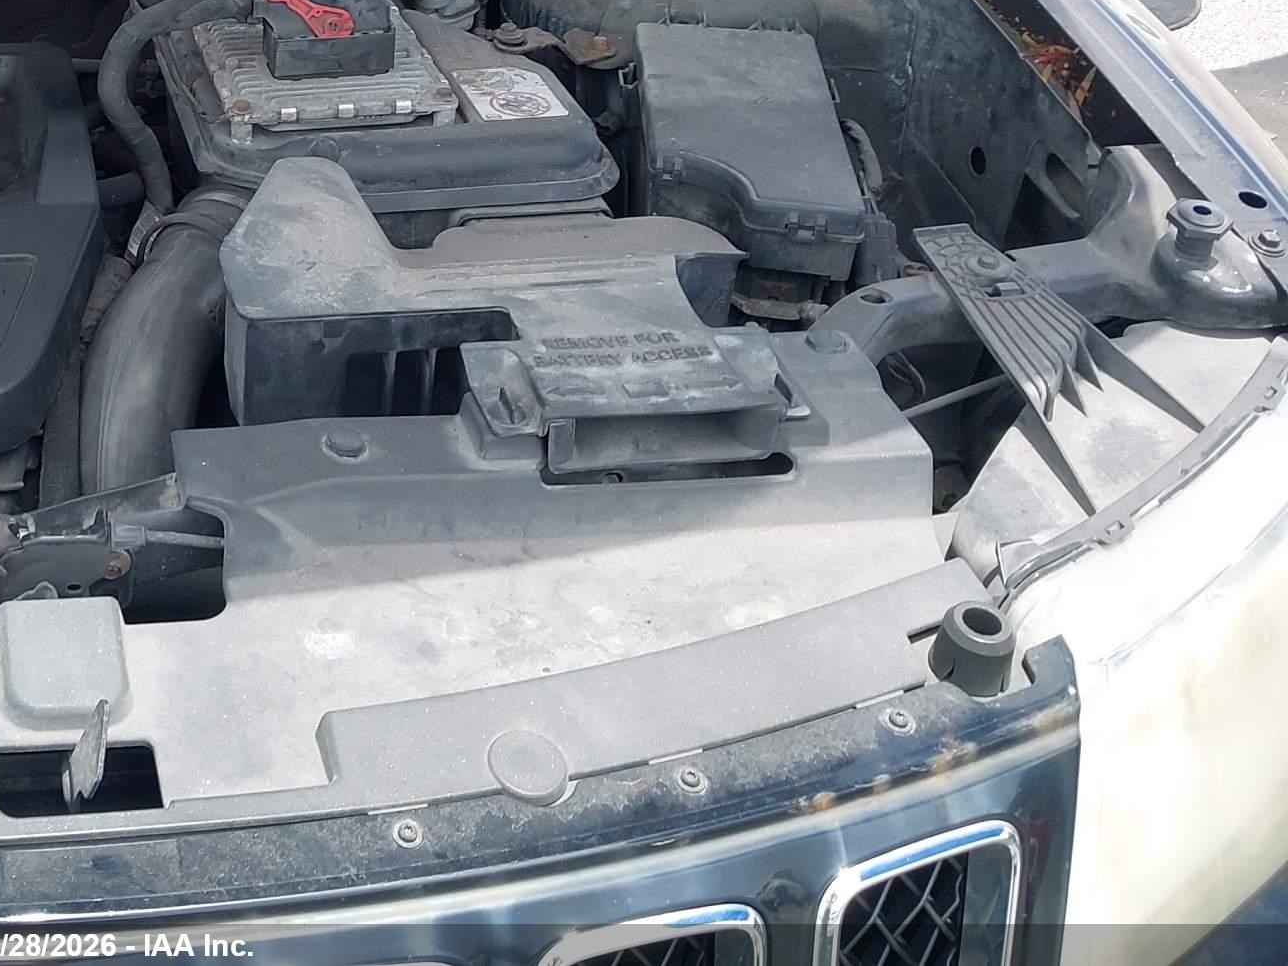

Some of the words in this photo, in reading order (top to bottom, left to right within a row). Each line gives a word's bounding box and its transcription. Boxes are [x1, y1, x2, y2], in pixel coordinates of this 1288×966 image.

[538, 335, 628, 351] REMOVE
[632, 331, 681, 345] FOR
[532, 353, 622, 369] BATTERY
[630, 345, 715, 364] ACCESS
